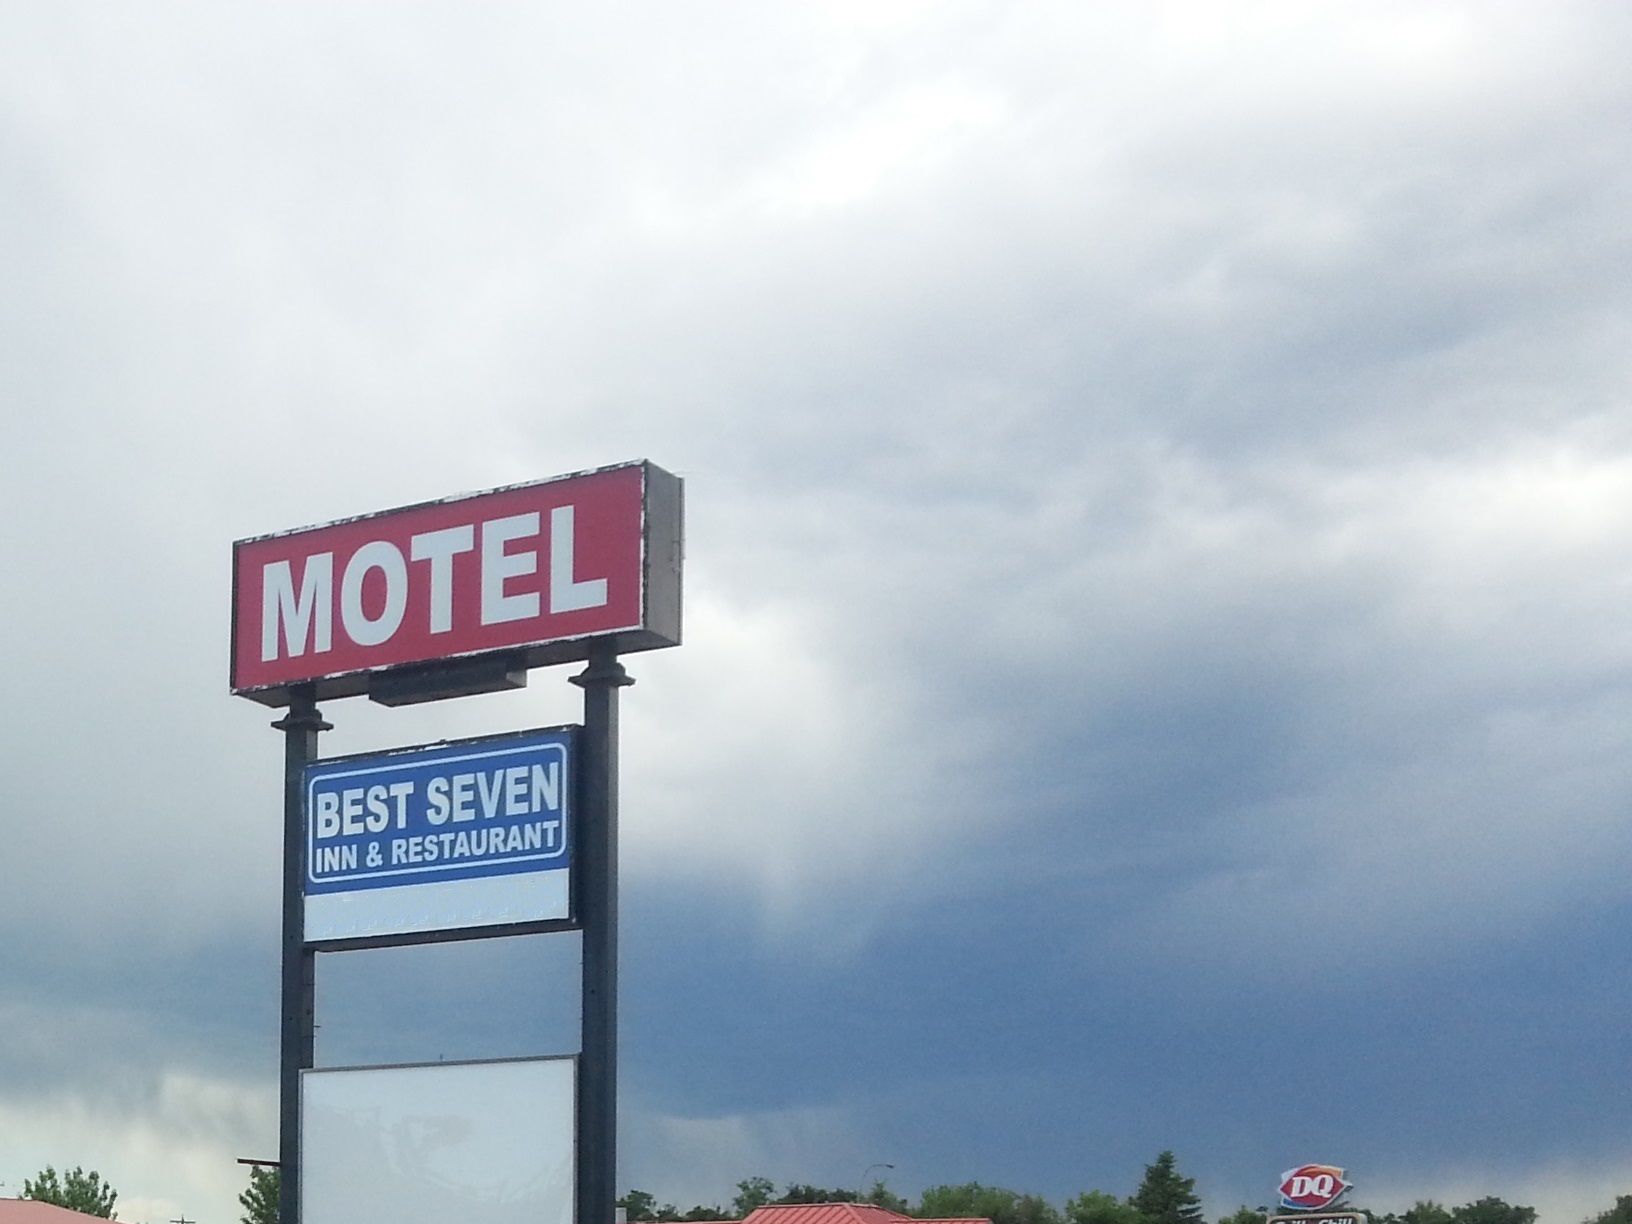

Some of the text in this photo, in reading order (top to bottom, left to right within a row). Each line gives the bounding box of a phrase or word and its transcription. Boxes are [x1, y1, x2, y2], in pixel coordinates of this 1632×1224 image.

[261, 505, 608, 662] MOTEL
[317, 762, 559, 839] BEST SEVEN
[316, 820, 560, 873] INN & RESTAURANT
[1290, 1174, 1334, 1198] DQ
